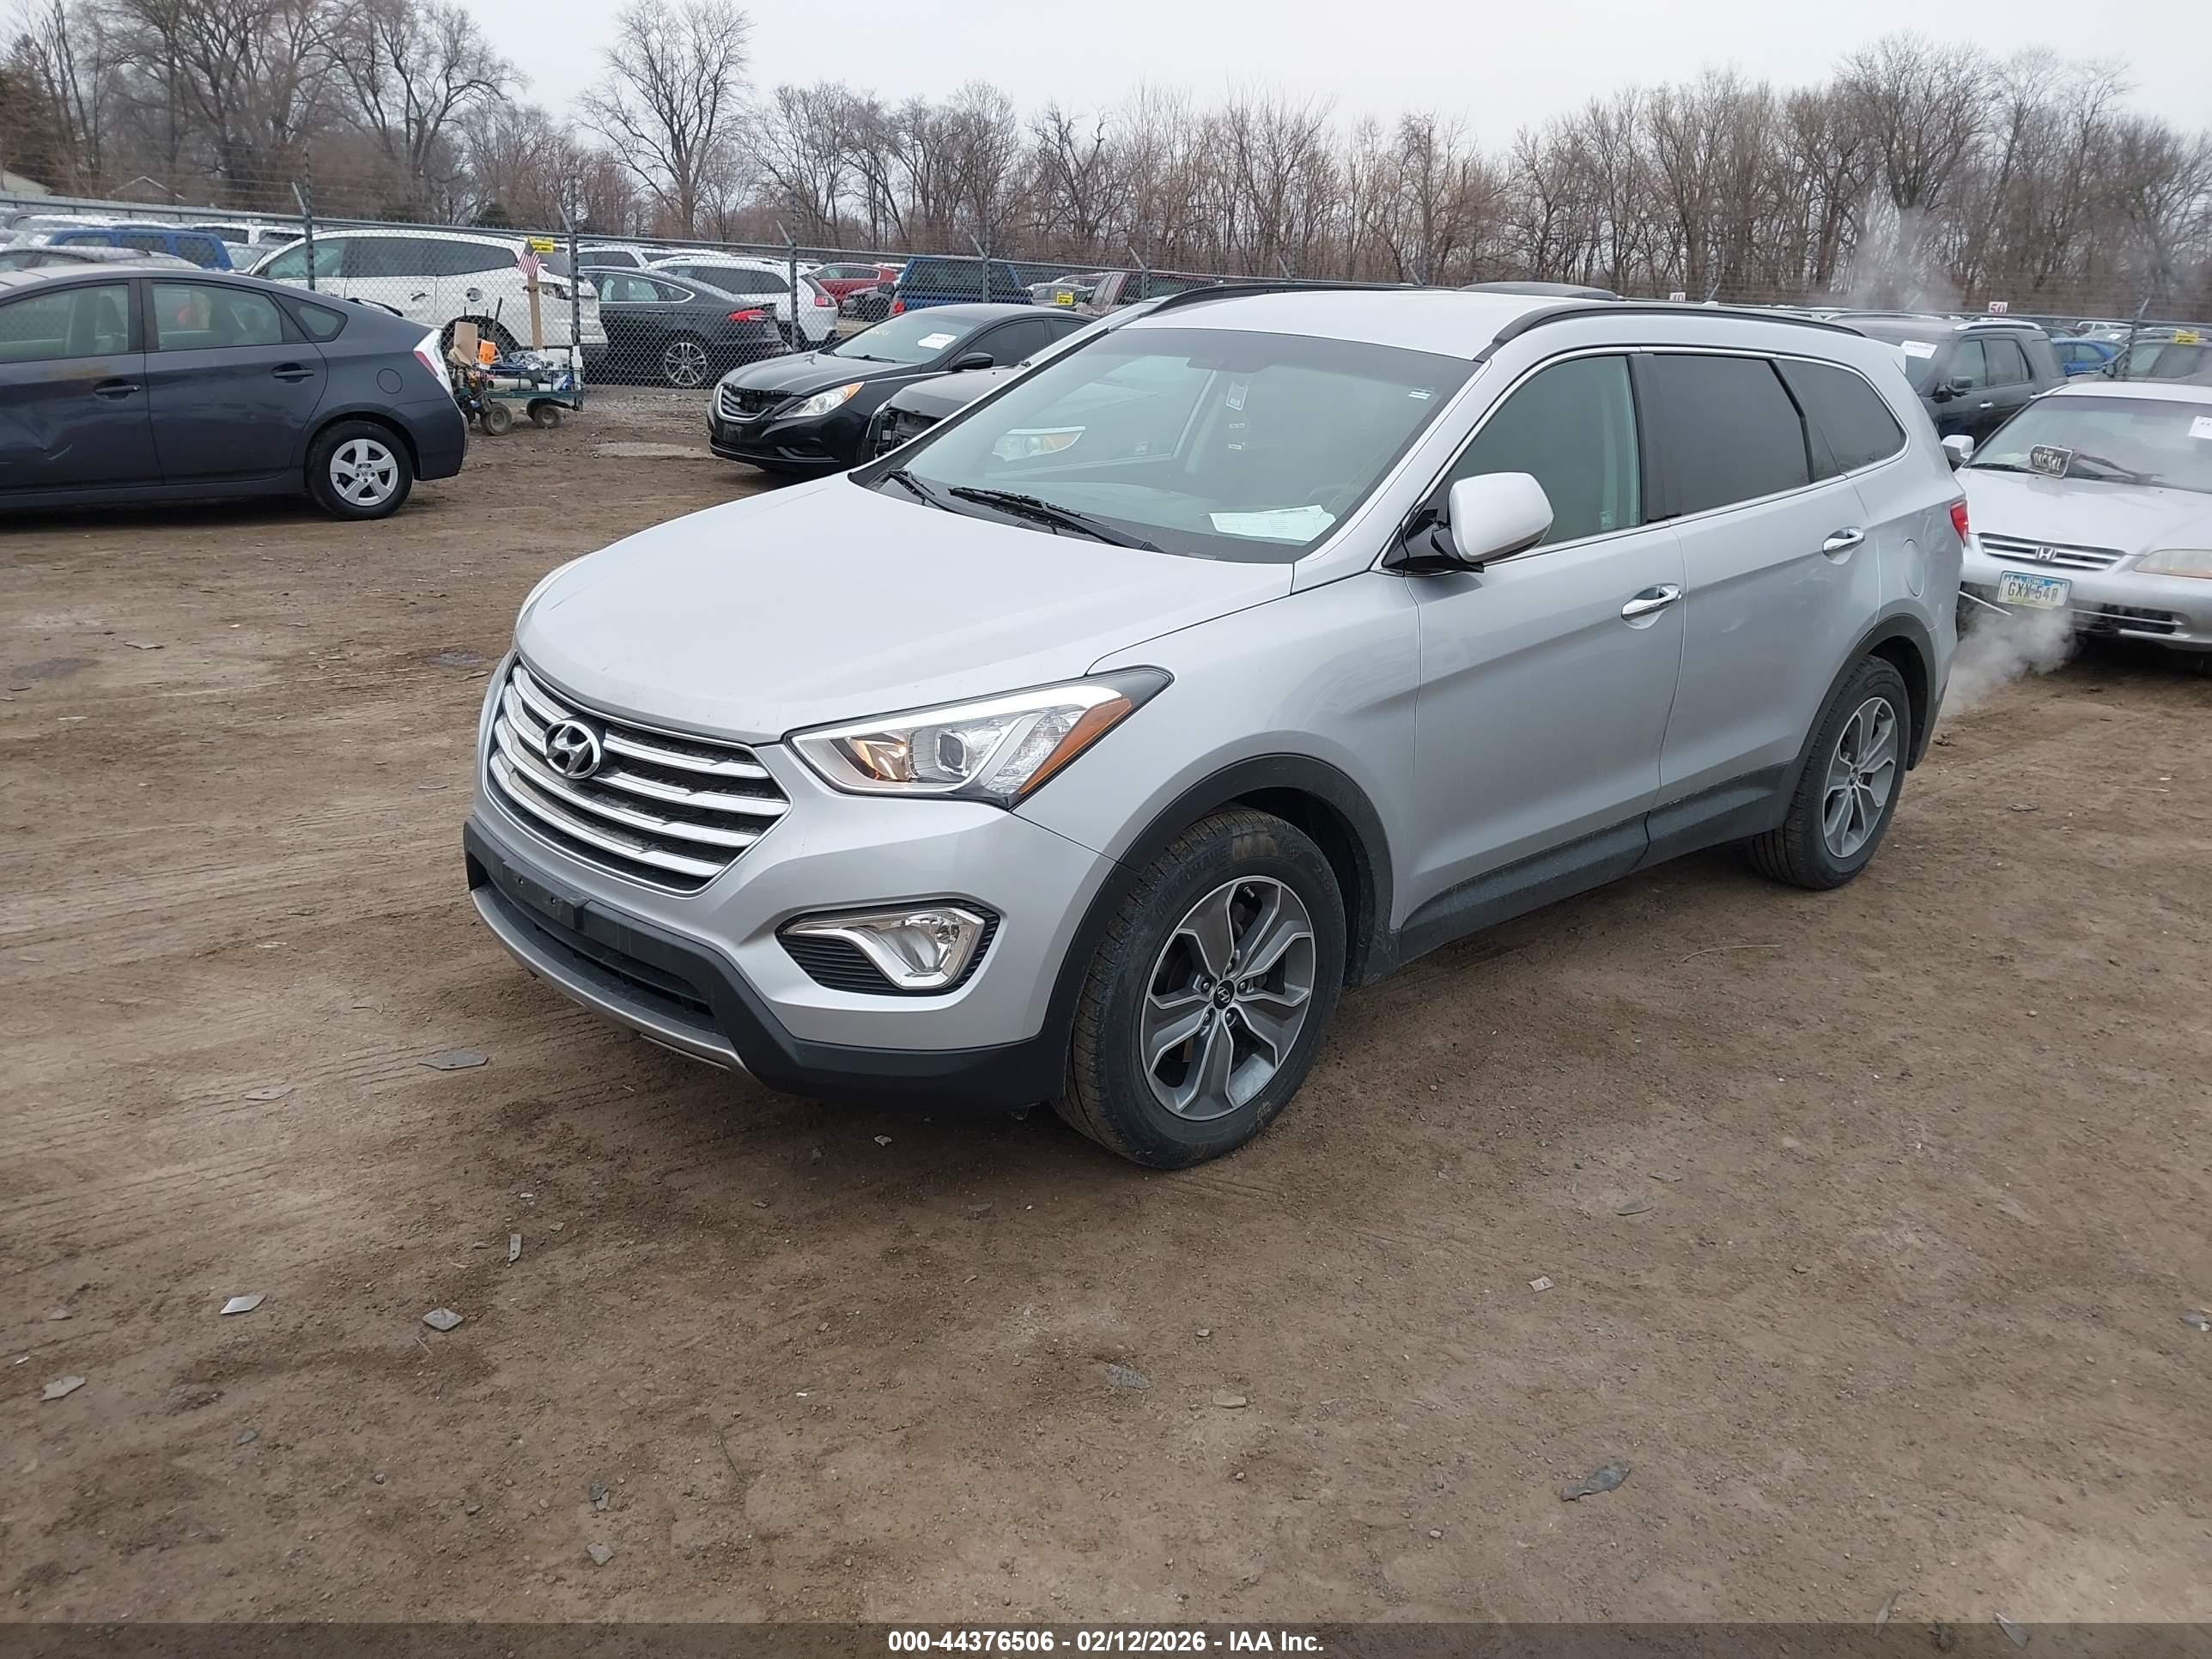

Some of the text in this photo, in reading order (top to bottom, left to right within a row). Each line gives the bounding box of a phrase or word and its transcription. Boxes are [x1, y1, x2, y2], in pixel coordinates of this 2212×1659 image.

[1990, 303, 2005, 313] 50
[2026, 577, 2045, 586] IOWA
[2008, 582, 2032, 598] GXX
